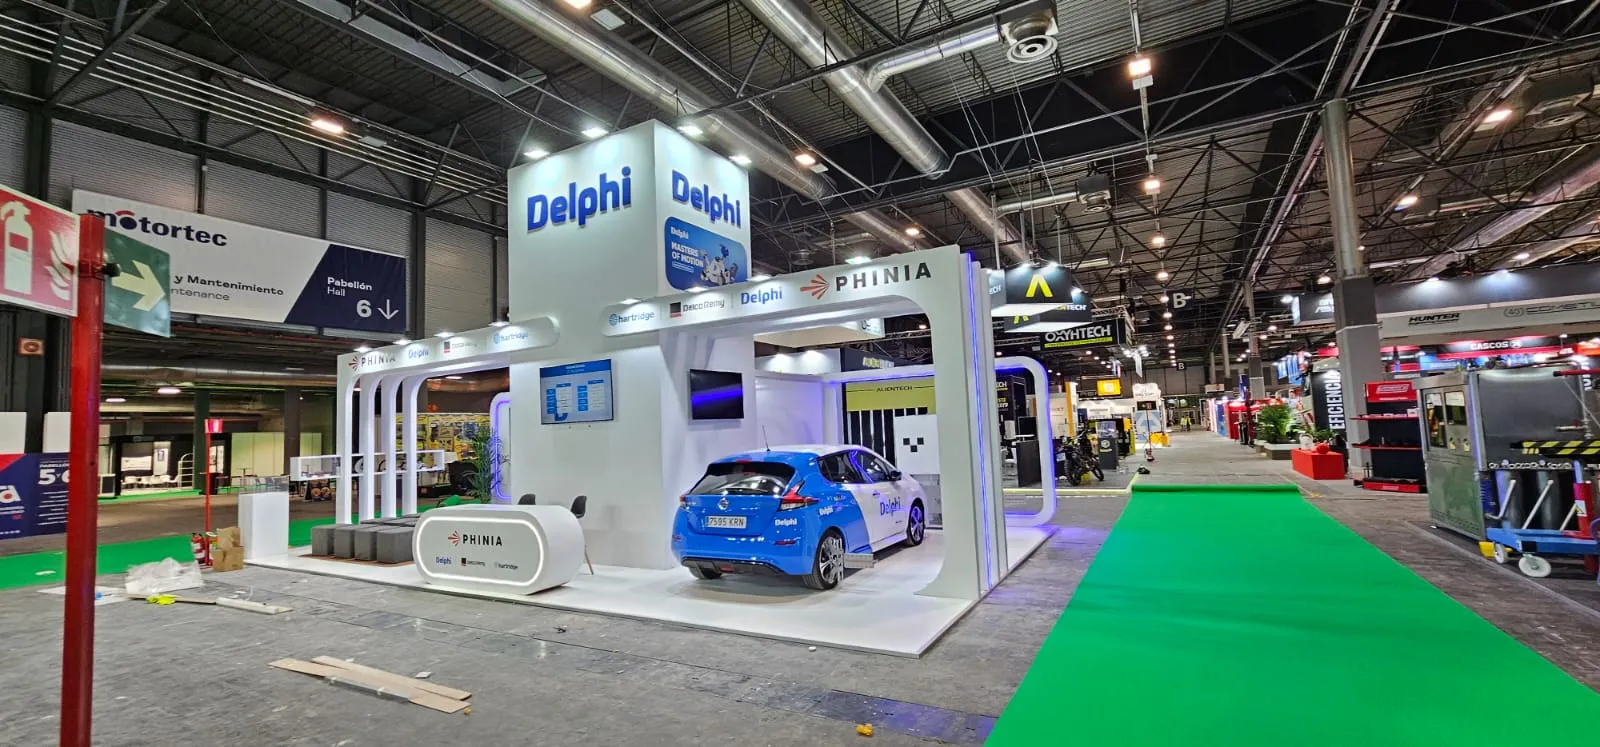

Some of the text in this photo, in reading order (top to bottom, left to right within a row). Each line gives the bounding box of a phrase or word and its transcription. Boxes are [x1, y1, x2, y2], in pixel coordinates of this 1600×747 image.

[527, 166, 631, 232] Delphi
[672, 169, 741, 227] Delphi
[671, 226, 688, 239] Delphi
[672, 242, 699, 256] MASTERS
[672, 252, 681, 261] OF
[681, 254, 704, 267] MOTION
[327, 276, 372, 291] Pabellón
[836, 262, 932, 291] PHINIA
[173, 275, 284, 295] y Mantenimiento
[327, 286, 345, 296] Hall
[171, 288, 230, 300] ntenance
[741, 286, 783, 305] Delphi
[356, 300, 372, 317] 6
[618, 311, 655, 323] hartridge
[1408, 313, 1460, 323] HUNTER
[1045, 325, 1111, 342] OXYHTECH
[1470, 341, 1508, 350] CASCOS
[361, 354, 396, 366] PHINIA
[38, 469, 56, 485] 5
[880, 496, 901, 517] Delphi
[710, 517, 744, 527] 7595 KRN
[775, 518, 798, 527] Delphi
[463, 534, 503, 546] PHINIA
